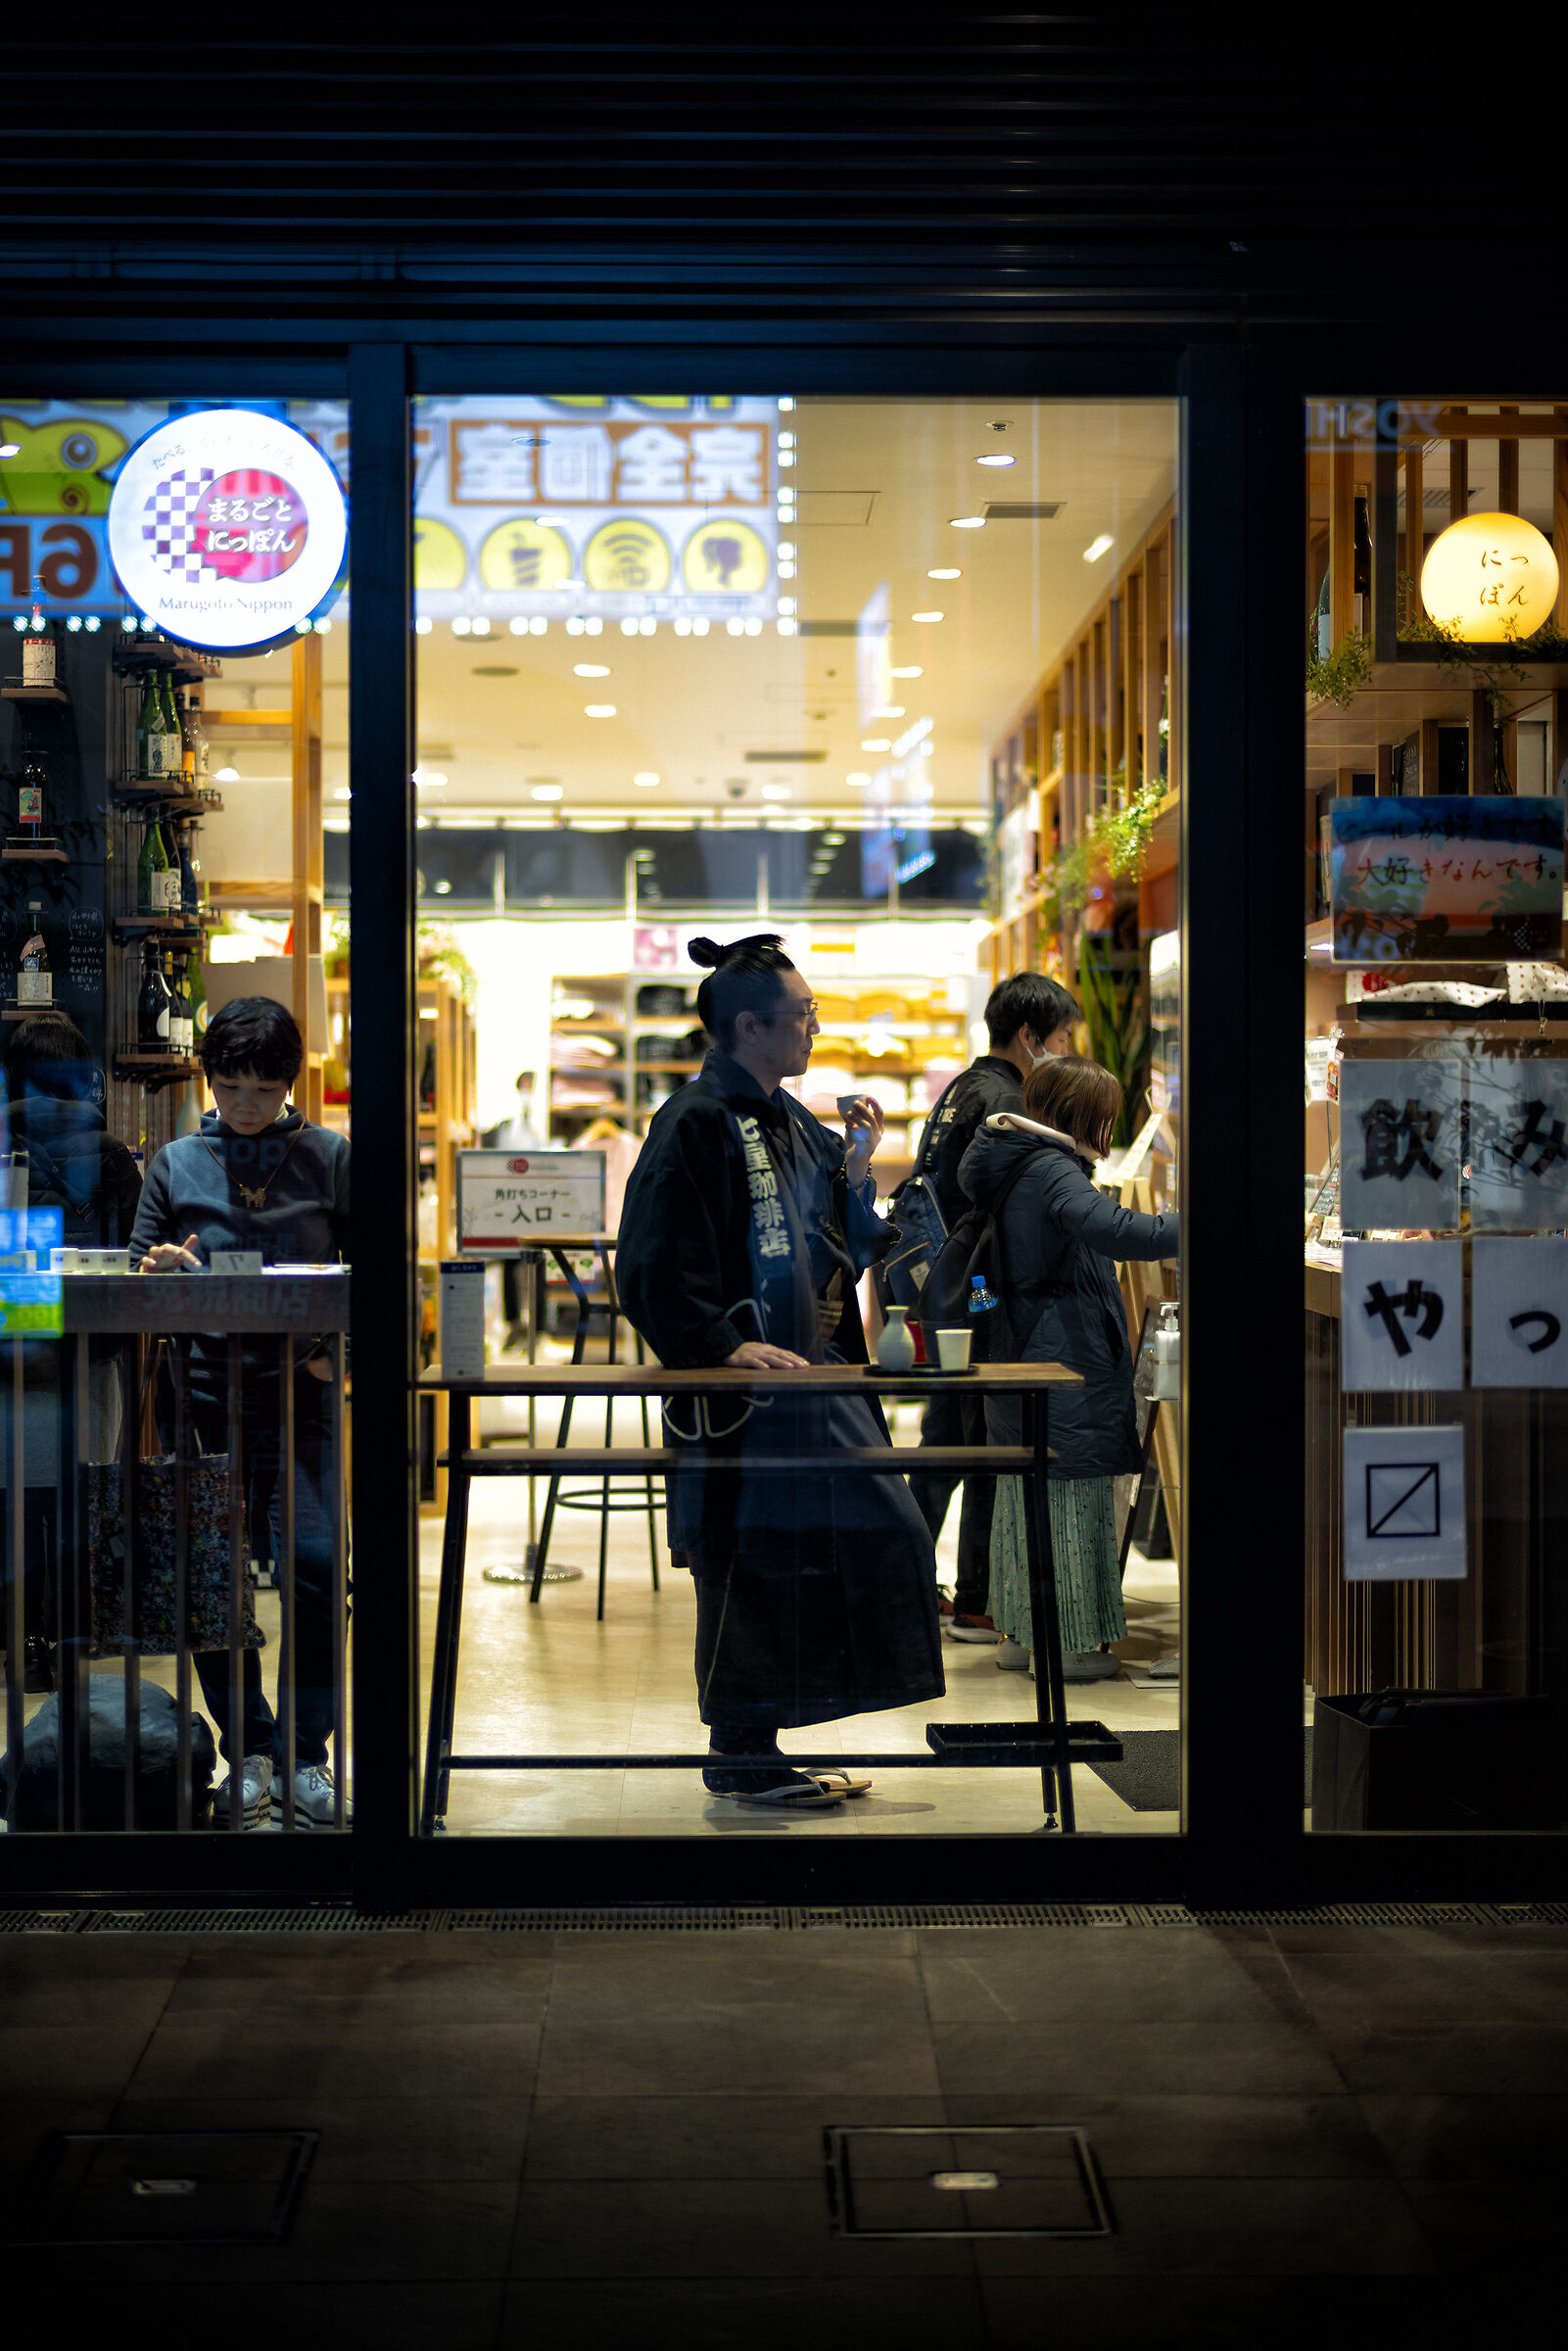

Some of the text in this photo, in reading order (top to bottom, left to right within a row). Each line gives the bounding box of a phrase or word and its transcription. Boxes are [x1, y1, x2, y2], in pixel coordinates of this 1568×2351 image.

[207, 497, 294, 524] まるごと
[207, 528, 297, 553] にっぽん
[1480, 550, 1529, 568] にっ
[159, 597, 233, 612] Marugoto
[1480, 583, 1529, 605] ぽん
[1357, 854, 1557, 888] 大好きなんです。
[495, 1188, 570, 1200] 角打ちコーナー
